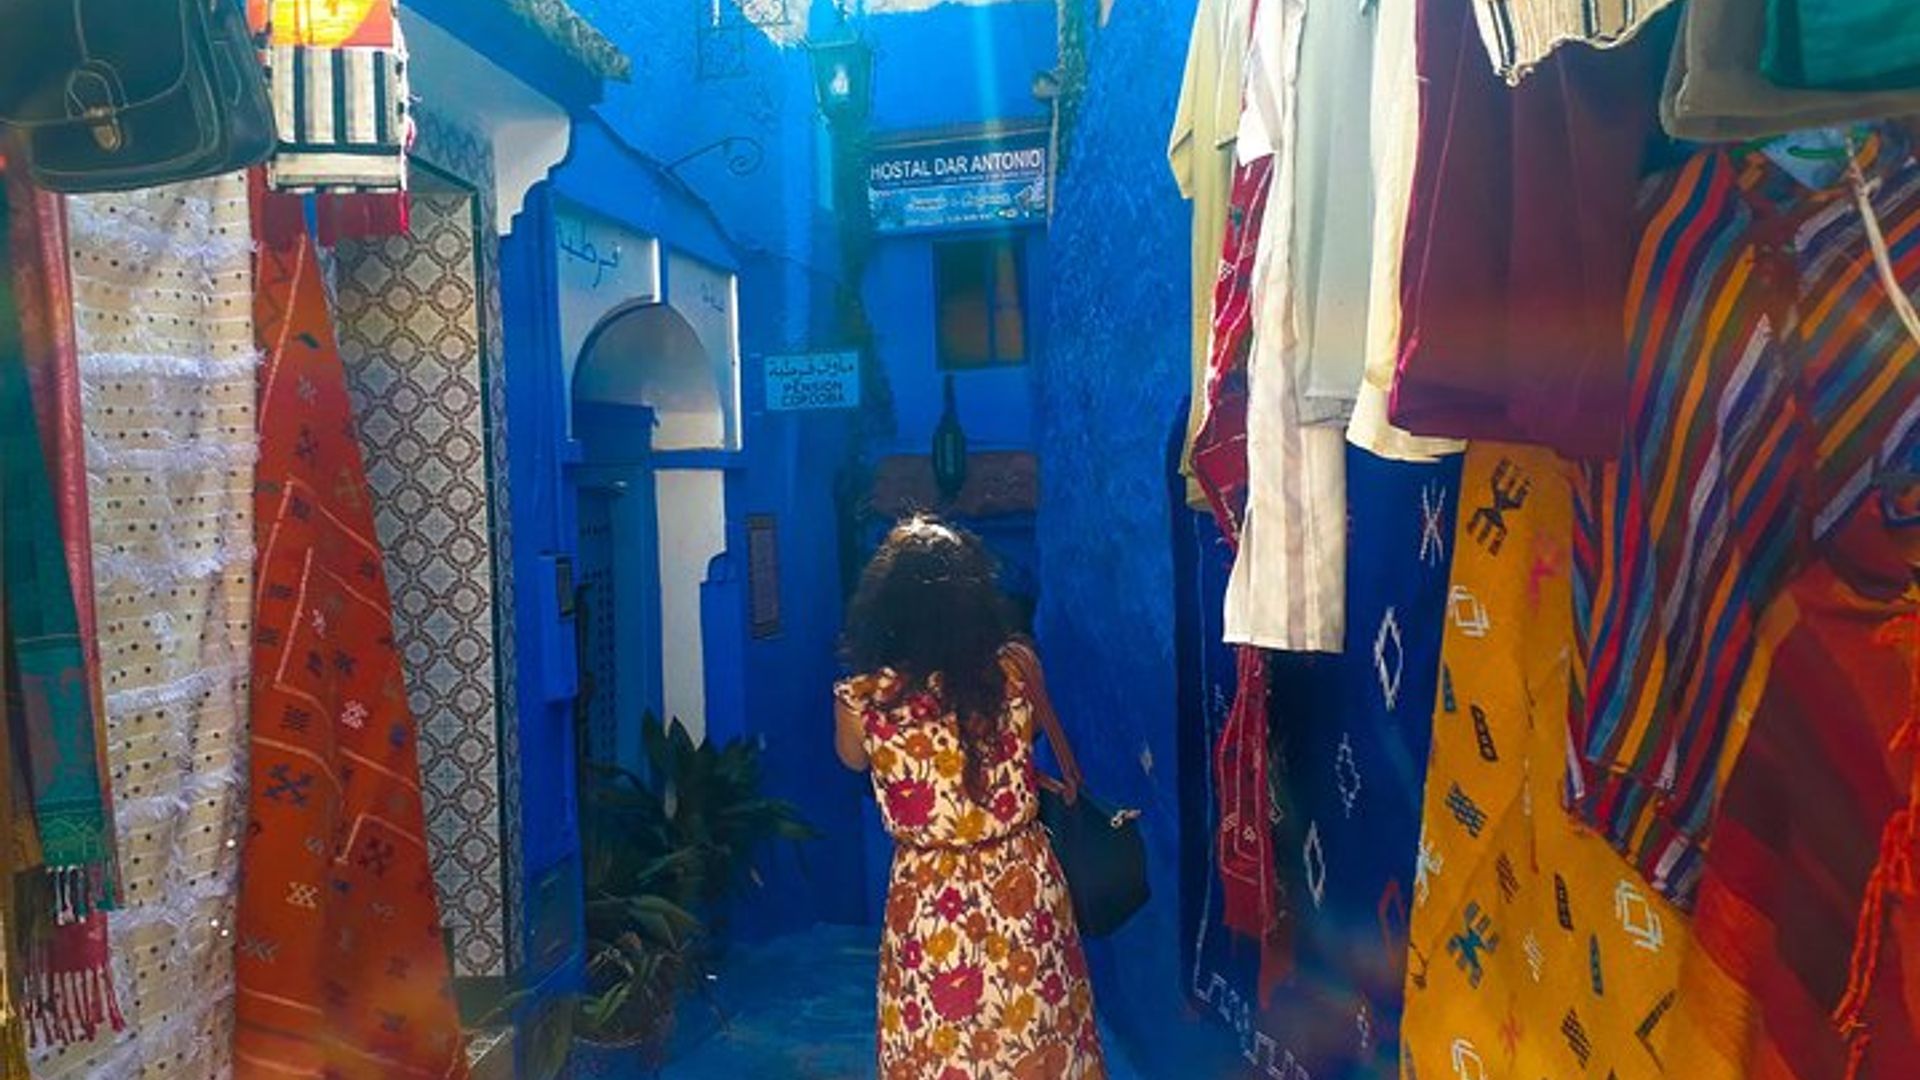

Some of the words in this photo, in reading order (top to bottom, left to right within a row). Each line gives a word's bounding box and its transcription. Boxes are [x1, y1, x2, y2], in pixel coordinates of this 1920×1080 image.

[870, 161, 932, 180] HOSTAL
[934, 155, 968, 175] DAR
[970, 150, 1041, 173] ANTONIO
[783, 380, 843, 394] PENSION
[782, 393, 844, 406] CORDOBA
